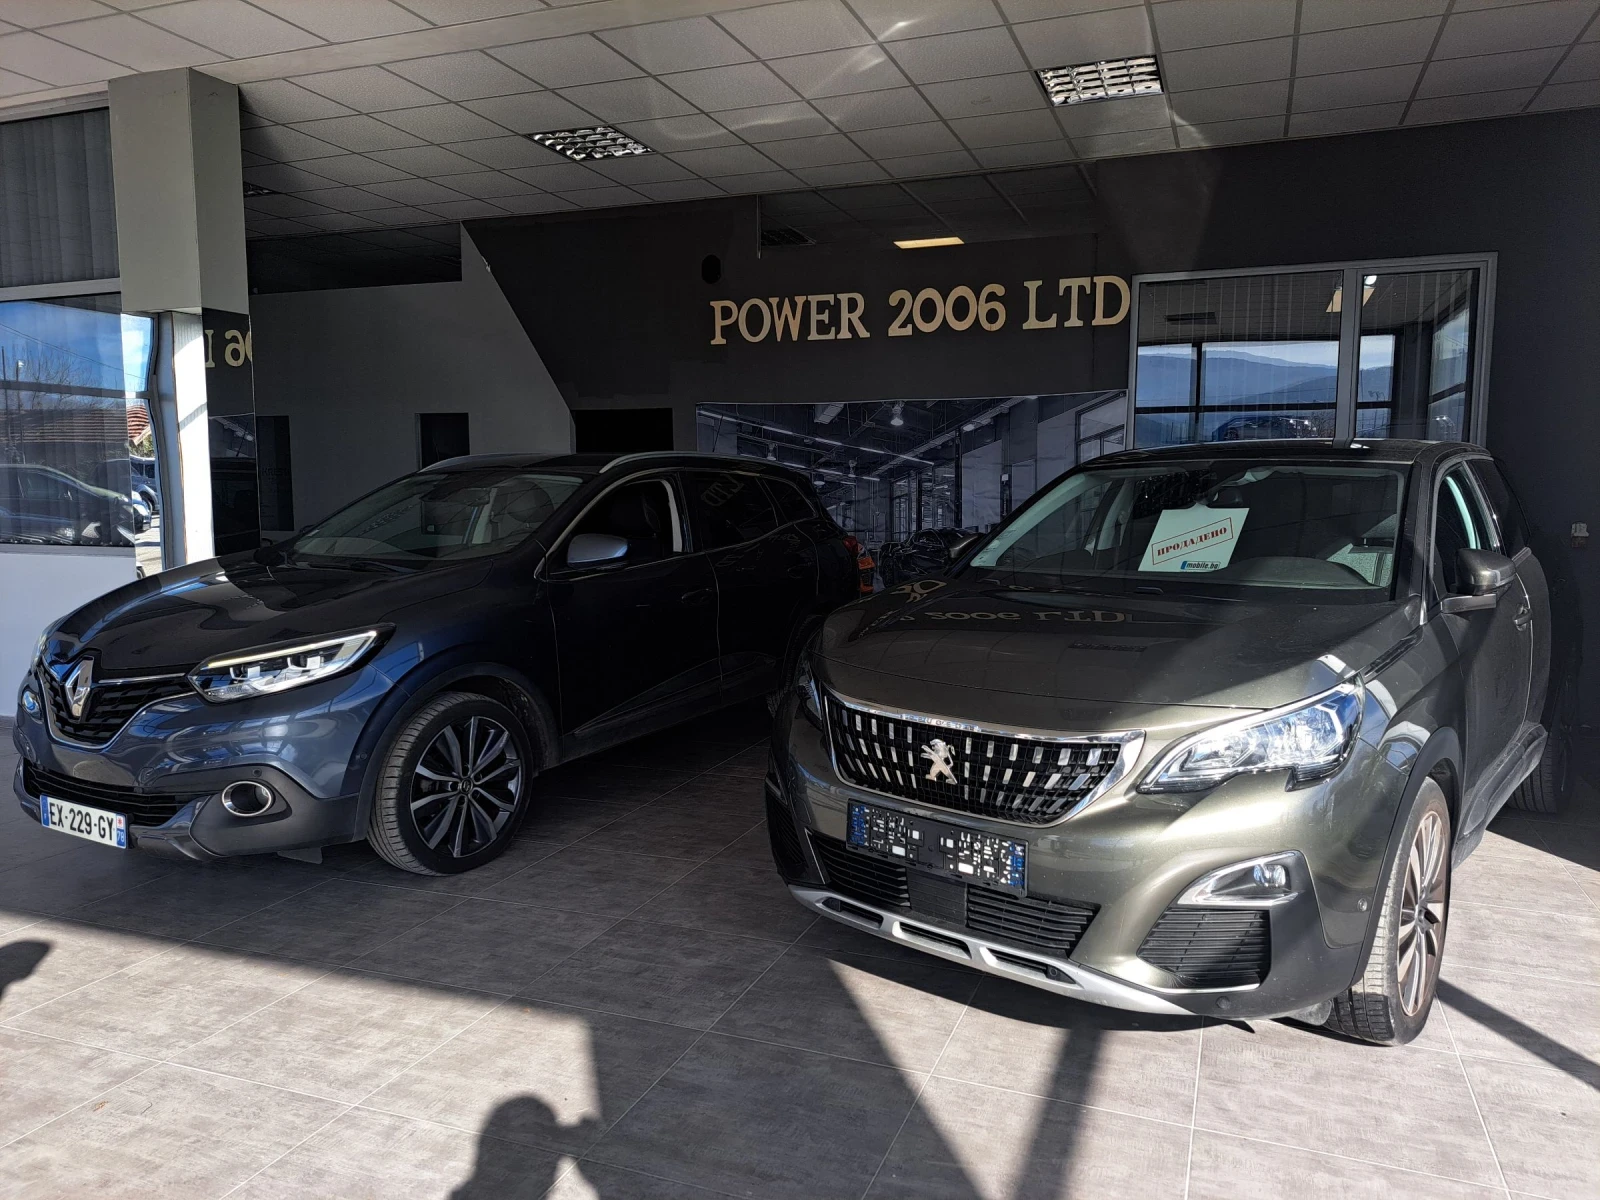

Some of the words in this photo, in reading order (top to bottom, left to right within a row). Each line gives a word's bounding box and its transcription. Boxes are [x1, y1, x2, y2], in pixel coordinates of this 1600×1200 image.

[710, 292, 870, 345] POWER
[888, 283, 1006, 337] 2006
[1023, 275, 1130, 330] LTD
[1157, 527, 1227, 556] ПРОДАДЕНО
[49, 802, 113, 840] EX-229-GY
[117, 830, 125, 843] 78
